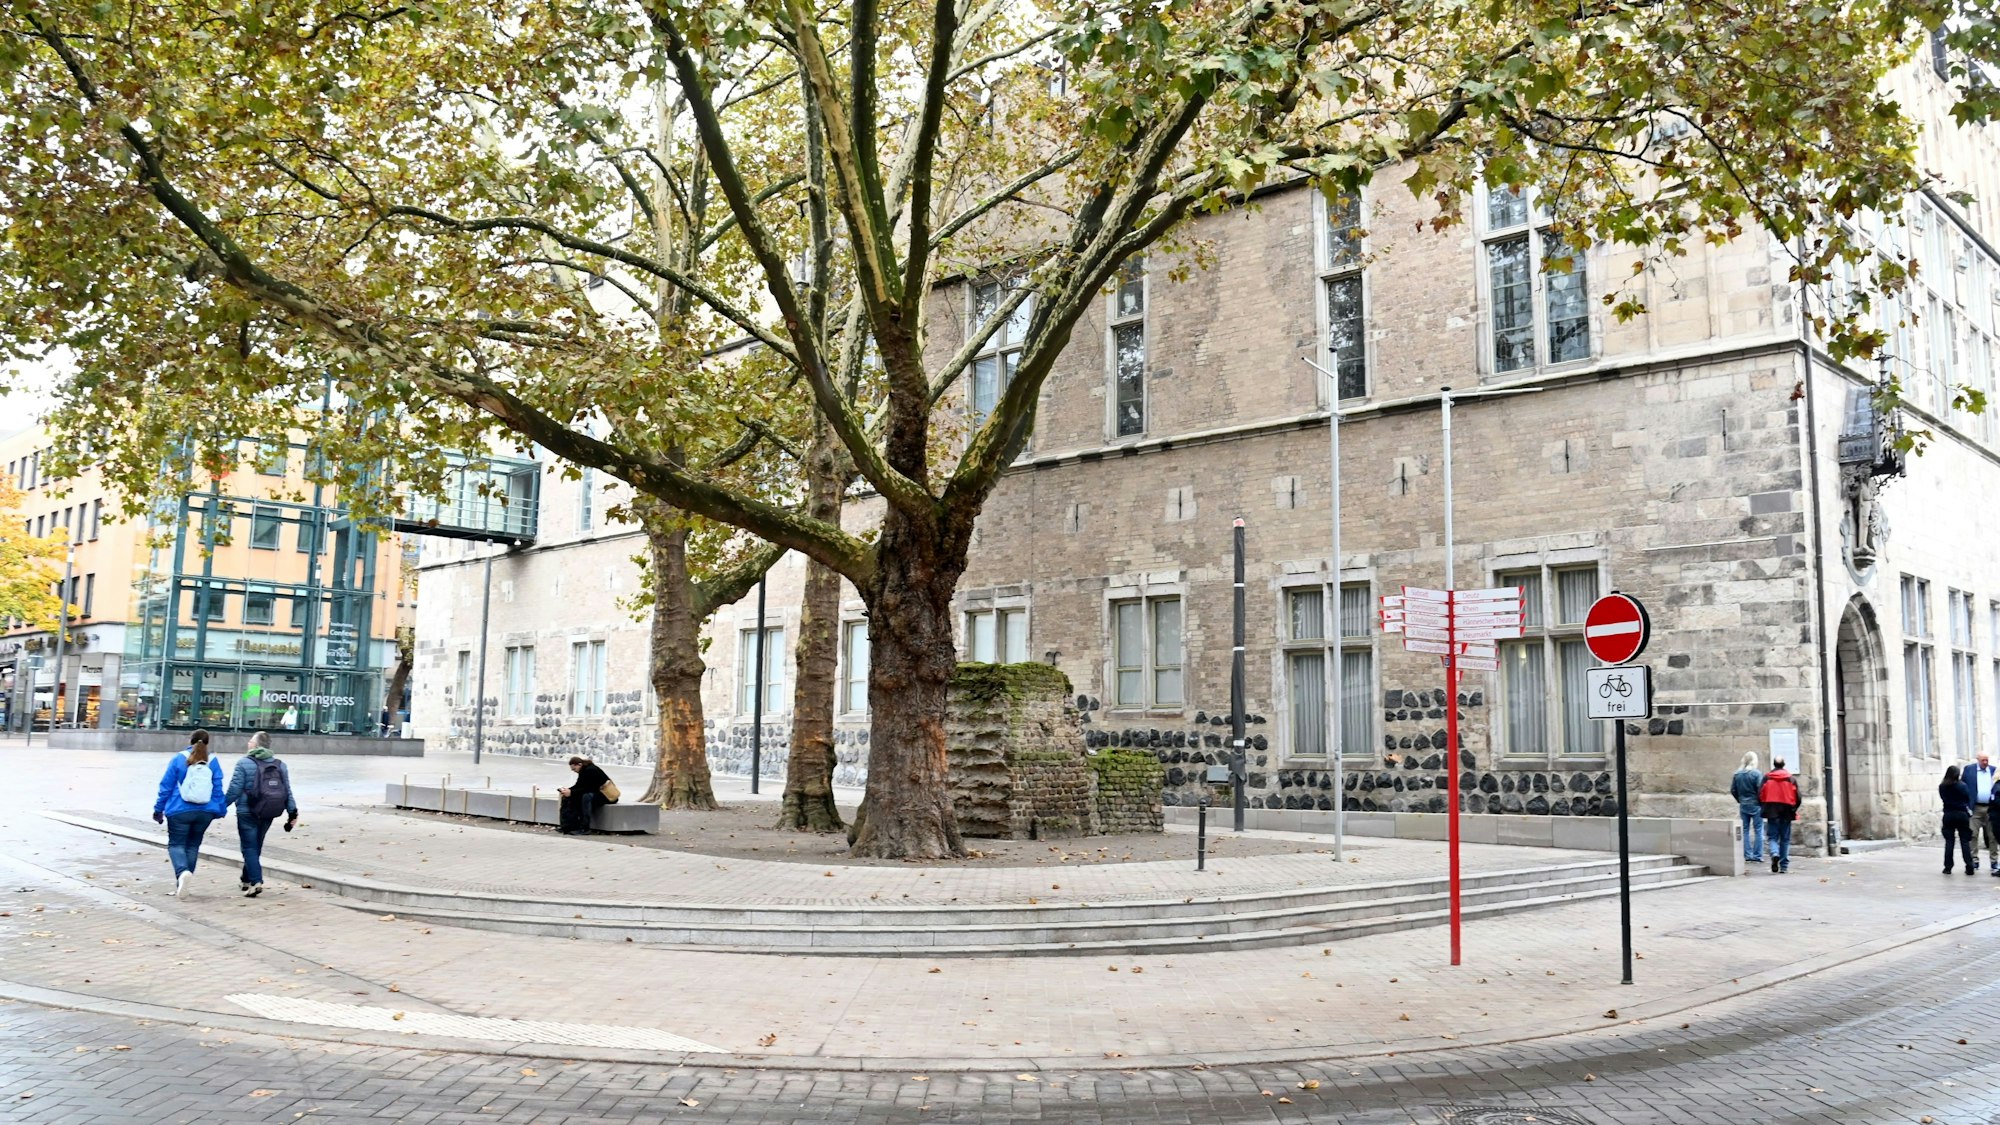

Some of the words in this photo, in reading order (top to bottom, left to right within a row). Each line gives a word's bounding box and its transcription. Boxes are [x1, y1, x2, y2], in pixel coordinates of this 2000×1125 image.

[1496, 616, 1516, 624] Theater
[1462, 631, 1492, 639] Heumarkt
[262, 690, 356, 708] koelncongress
[1607, 701, 1626, 712] frei
